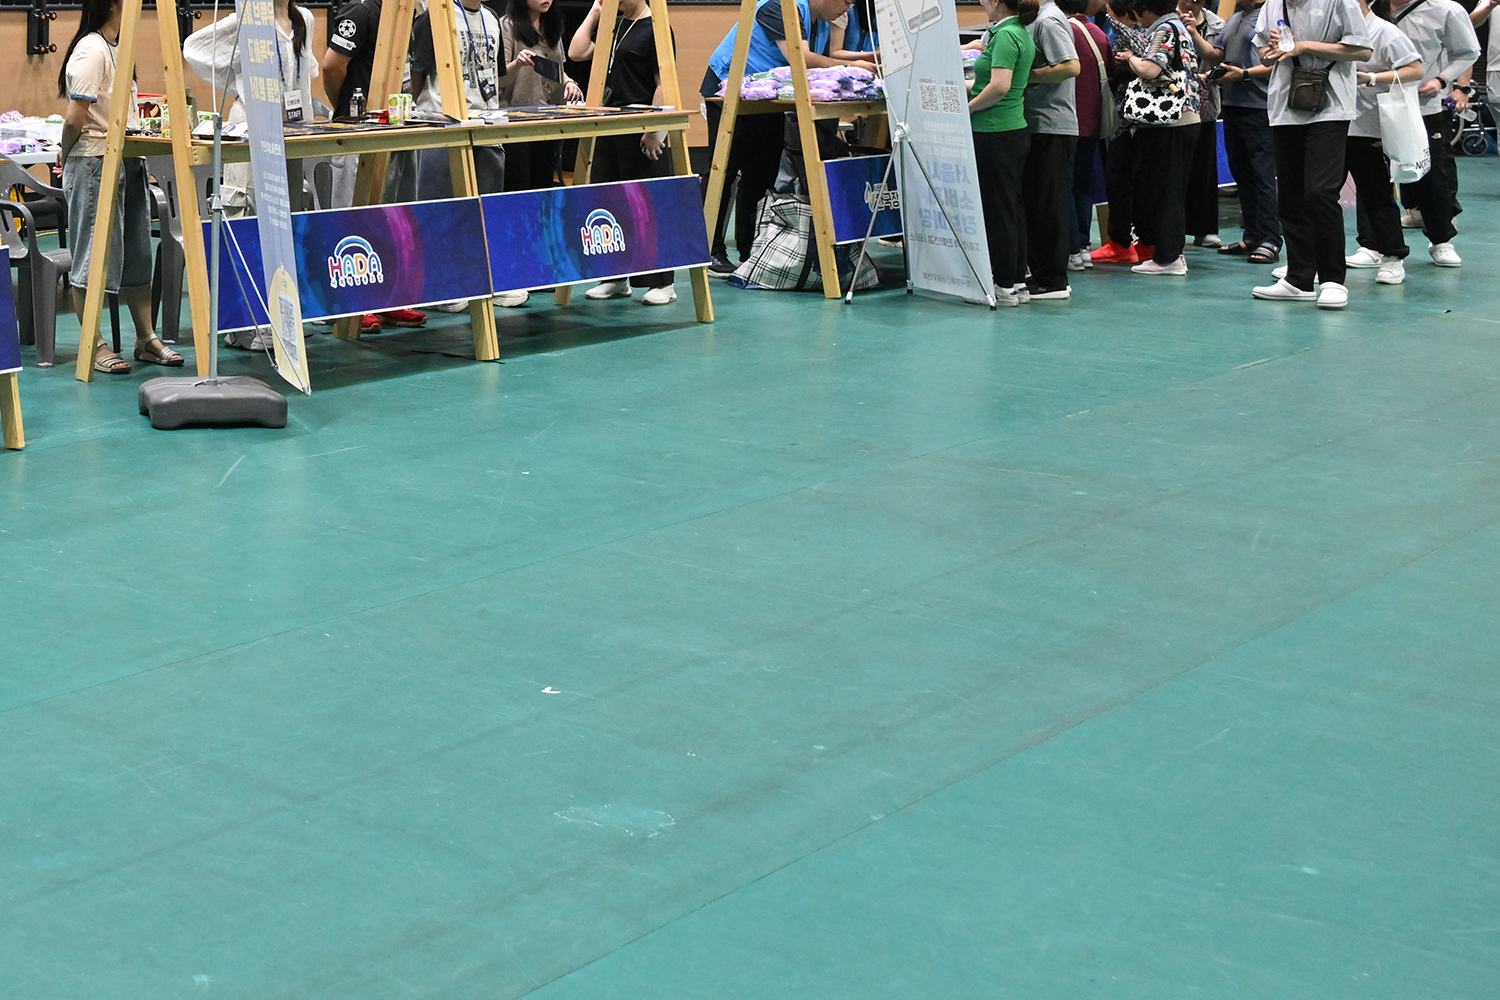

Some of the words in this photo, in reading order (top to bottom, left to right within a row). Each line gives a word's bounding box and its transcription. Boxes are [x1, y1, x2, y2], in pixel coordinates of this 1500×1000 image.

[288, 110, 301, 119] STAFF
[581, 223, 624, 247] HADA
[328, 252, 382, 278] HADA
